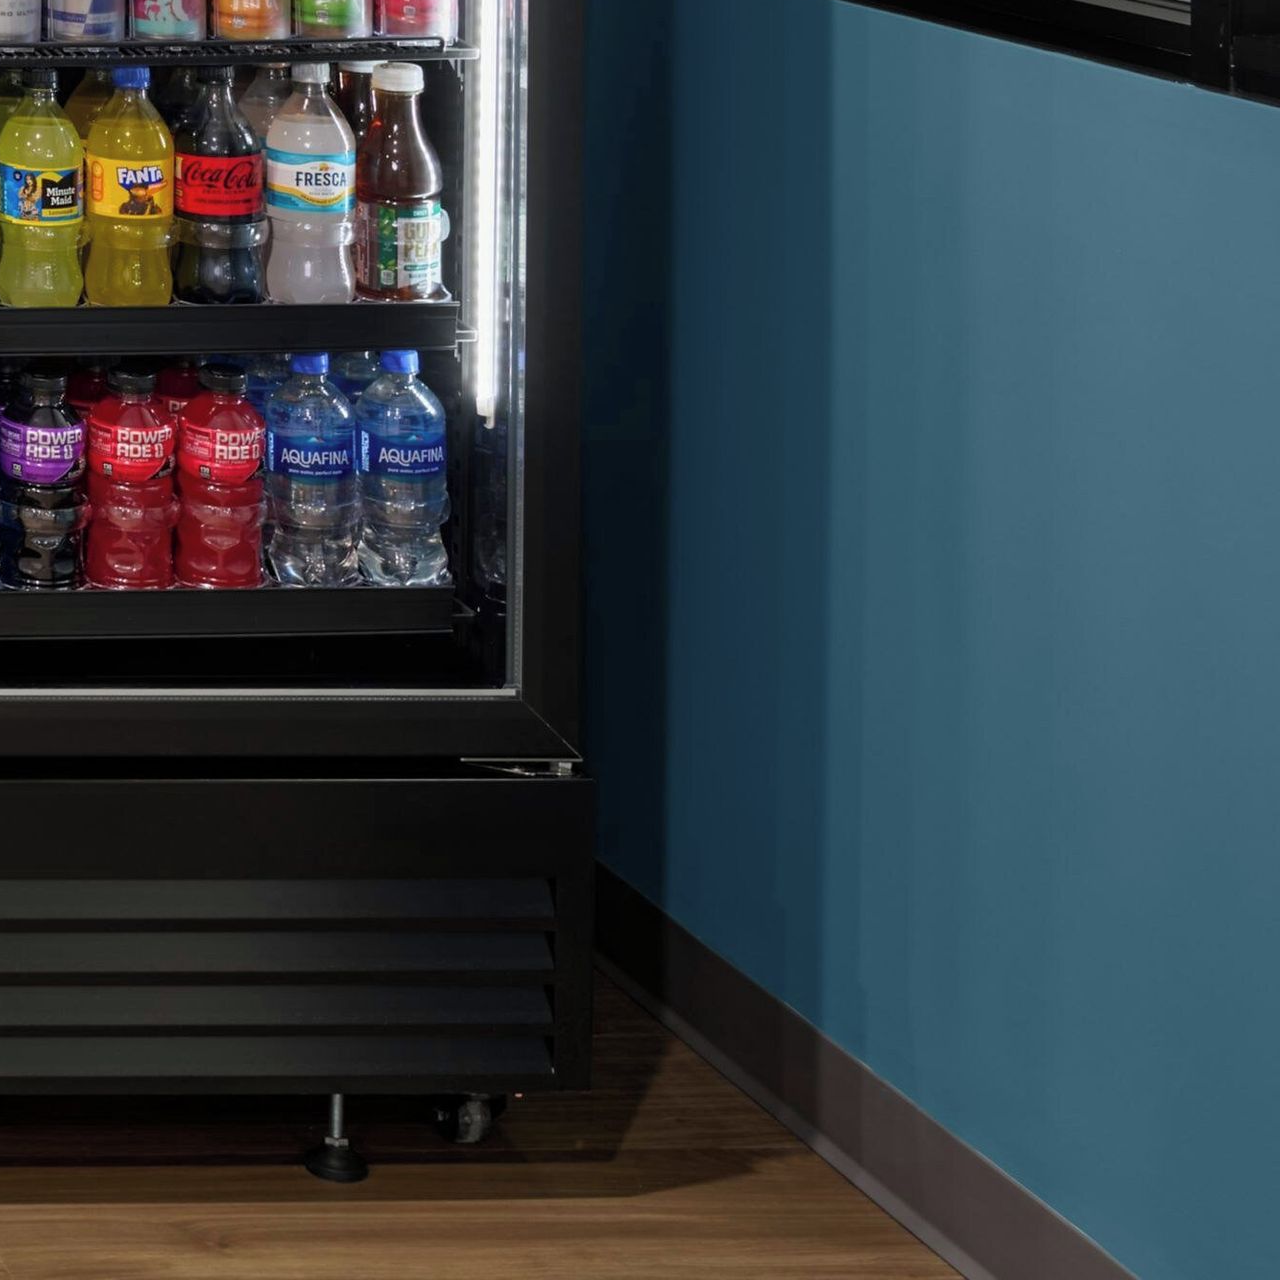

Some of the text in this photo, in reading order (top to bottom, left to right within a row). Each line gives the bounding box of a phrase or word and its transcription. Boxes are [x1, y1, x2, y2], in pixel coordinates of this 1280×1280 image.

[117, 166, 163, 184] FANTA
[182, 161, 258, 191] Coca-Cola
[295, 171, 347, 187] FRESCA
[46, 187, 76, 198] Minute
[51, 197, 73, 206] Maid
[25, 429, 83, 444] POWER
[117, 428, 172, 444] POWER
[25, 445, 60, 459] ADE
[116, 445, 151, 458] ADE
[281, 447, 349, 468] AQUAFINA
[378, 447, 444, 467] AQUAFINA
